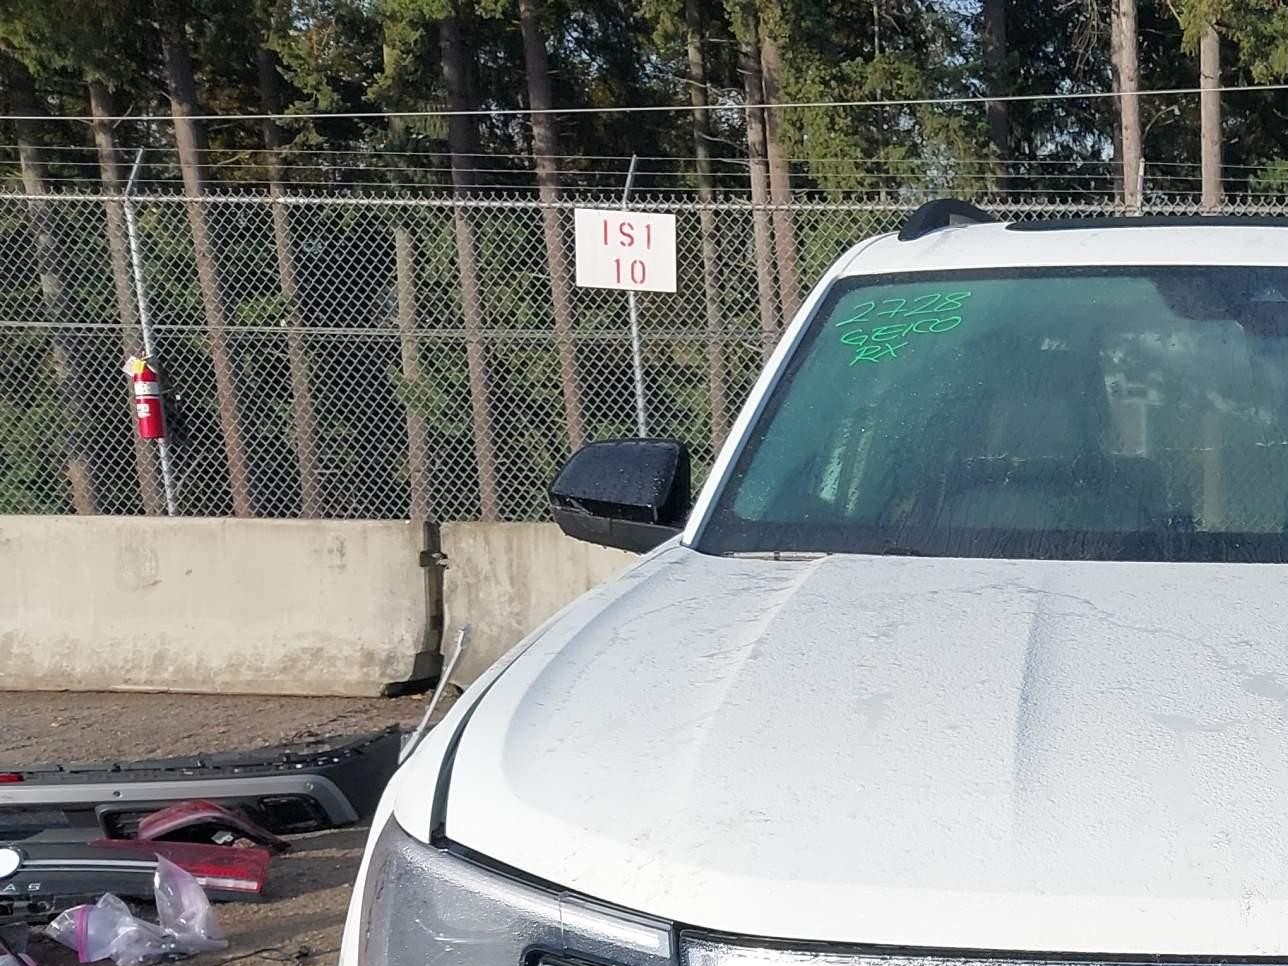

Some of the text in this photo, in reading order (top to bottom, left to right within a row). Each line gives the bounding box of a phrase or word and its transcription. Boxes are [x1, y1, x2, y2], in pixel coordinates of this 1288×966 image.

[614, 258, 646, 284] 10
[835, 291, 971, 327] 2728
[840, 316, 962, 346] GEICO
